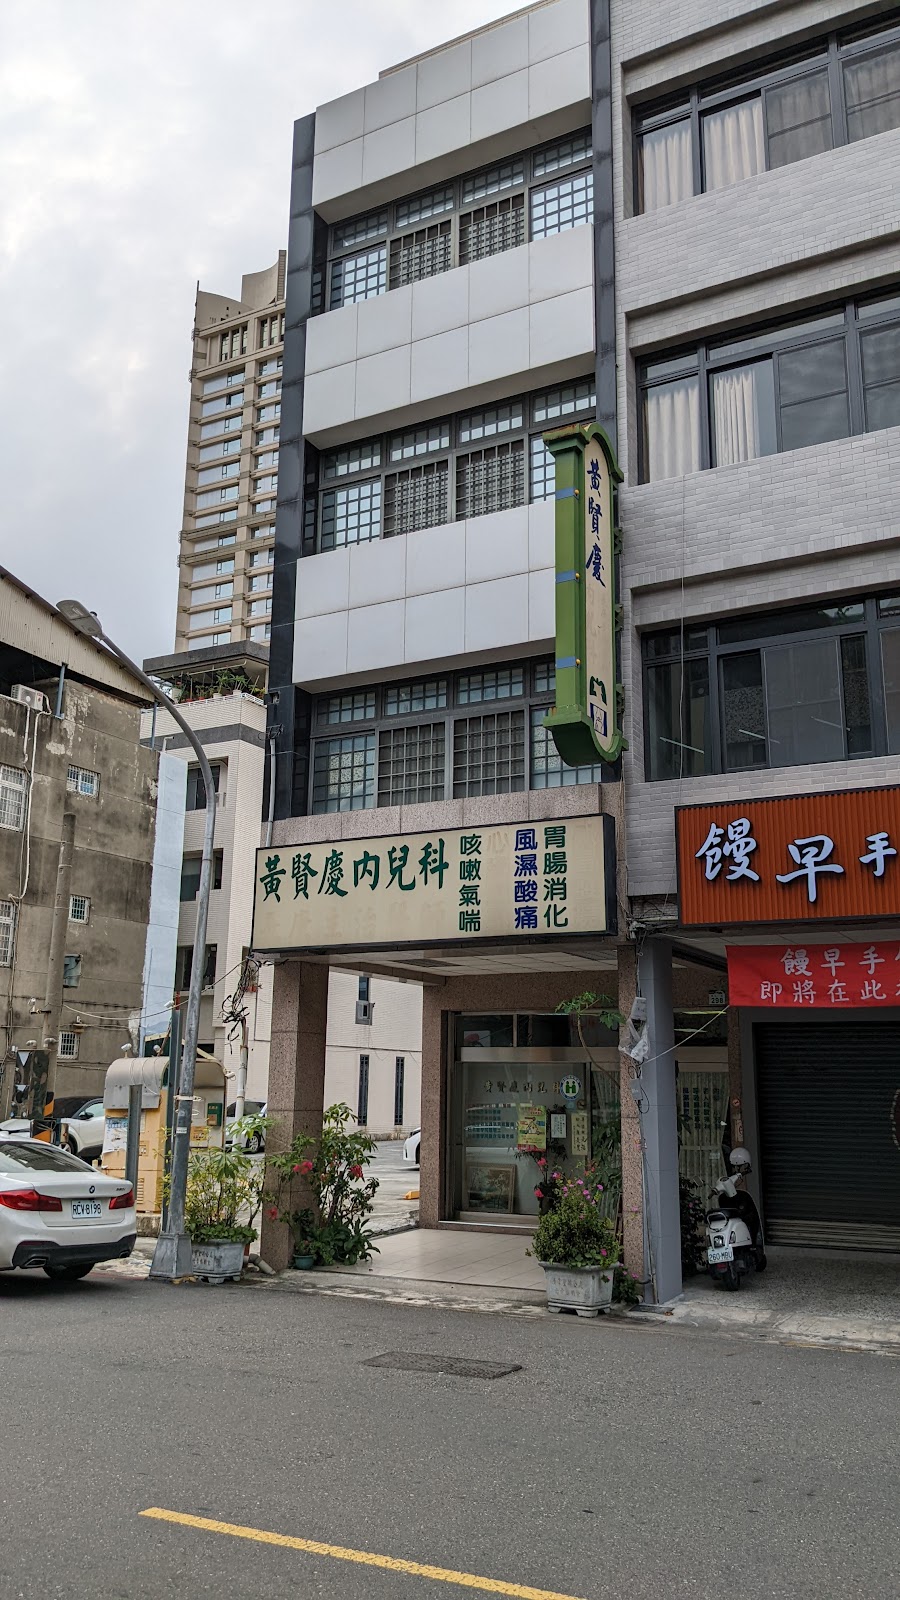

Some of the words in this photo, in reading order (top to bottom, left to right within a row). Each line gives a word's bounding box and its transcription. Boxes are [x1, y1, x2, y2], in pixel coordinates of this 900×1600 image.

[586, 458, 606, 588] 黃賢慶
[459, 834, 482, 932] 咳嗽氣喘
[514, 829, 538, 929] 風濕酸痛
[543, 826, 569, 928] 胃腸消化
[695, 817, 897, 903] 饅早手
[760, 979, 900, 1004] 即將在此
[780, 946, 900, 977] 饅早手
